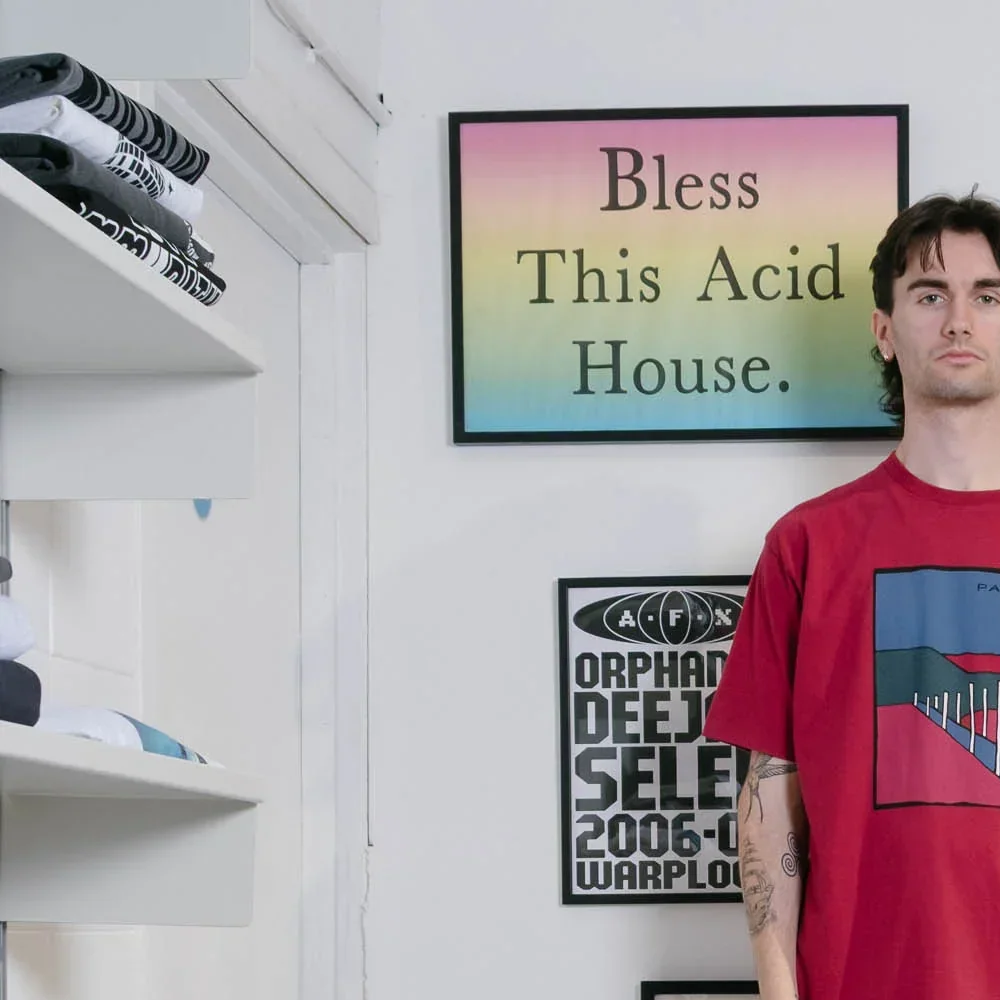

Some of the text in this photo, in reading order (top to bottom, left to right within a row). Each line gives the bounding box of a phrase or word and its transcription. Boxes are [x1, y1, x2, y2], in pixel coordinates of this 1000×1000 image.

[599, 147, 760, 212] Bless
[517, 242, 845, 304] This Acid
[572, 339, 790, 395] House.
[574, 690, 719, 744] DEEJ
